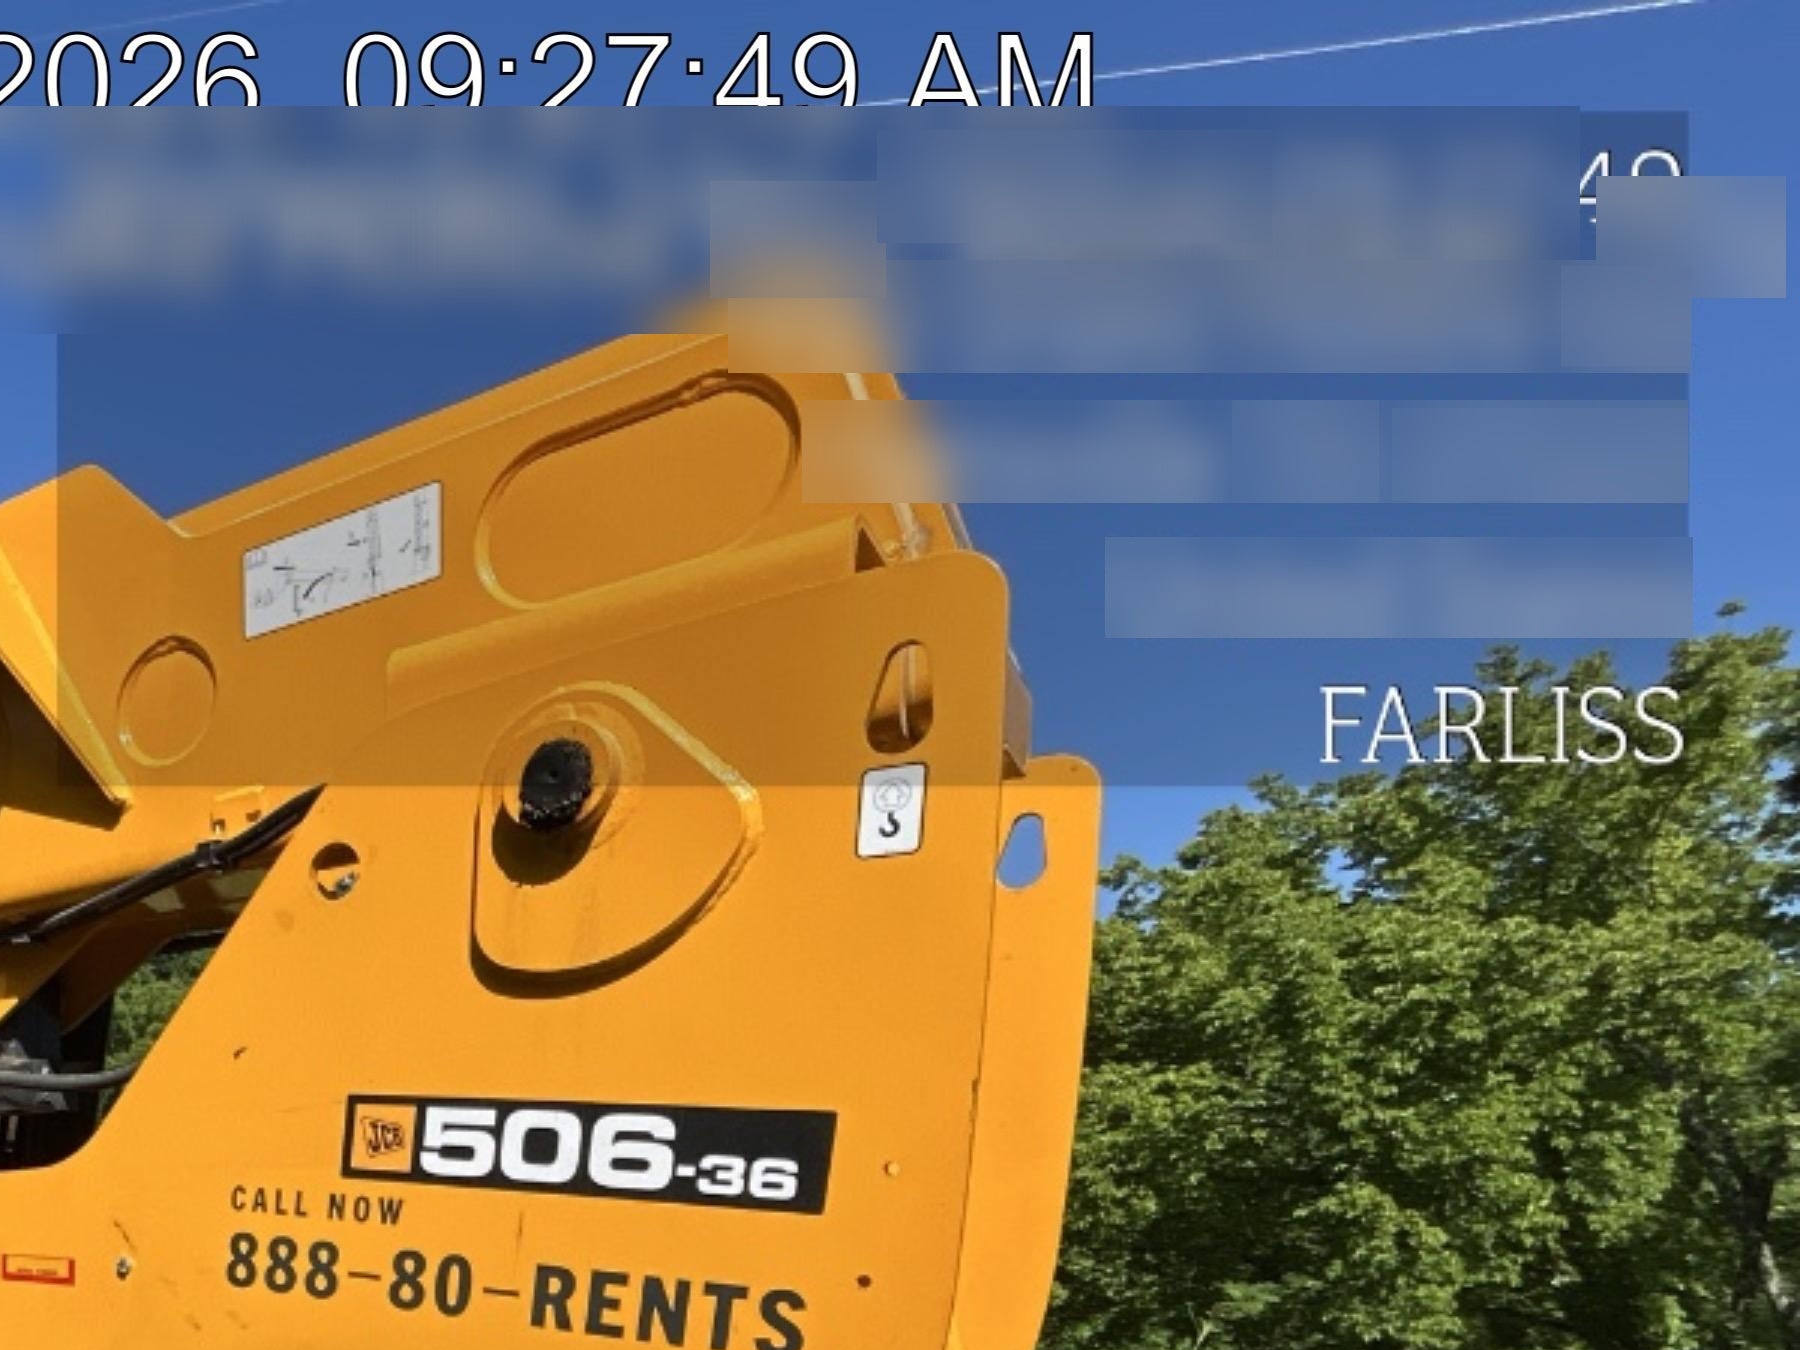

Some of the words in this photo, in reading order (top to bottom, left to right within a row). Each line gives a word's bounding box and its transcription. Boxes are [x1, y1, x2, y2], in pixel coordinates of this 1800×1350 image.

[419, 1105, 800, 1201] 506-36
[230, 1184, 309, 1218] CALL
[327, 1192, 405, 1226] NOW
